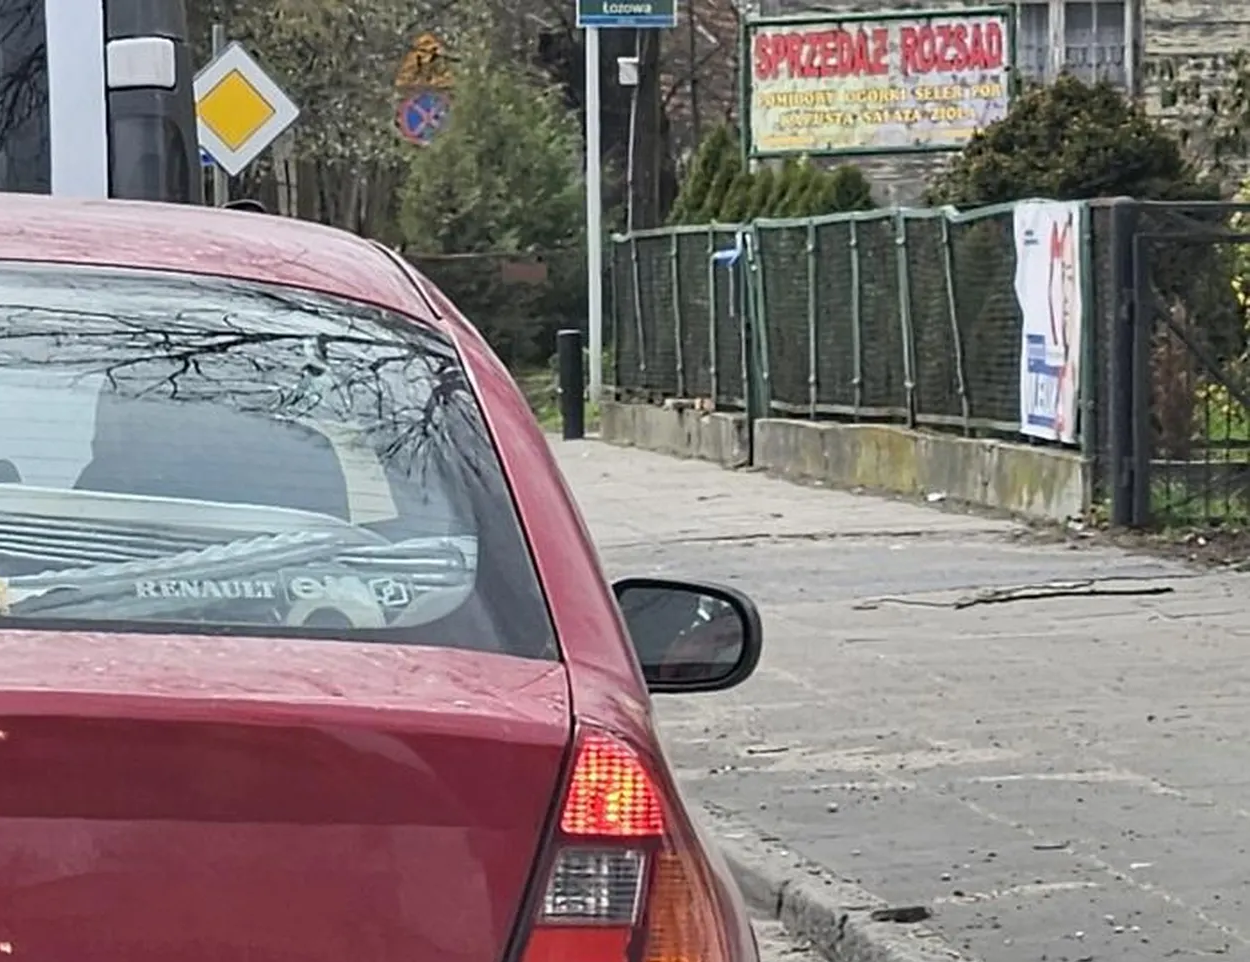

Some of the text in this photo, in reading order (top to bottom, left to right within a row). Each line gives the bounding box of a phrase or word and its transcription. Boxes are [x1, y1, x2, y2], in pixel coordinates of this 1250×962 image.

[900, 21, 1004, 76] ROZSAD
[780, 111, 852, 127] USTA
[135, 579, 276, 598] RENAULT
